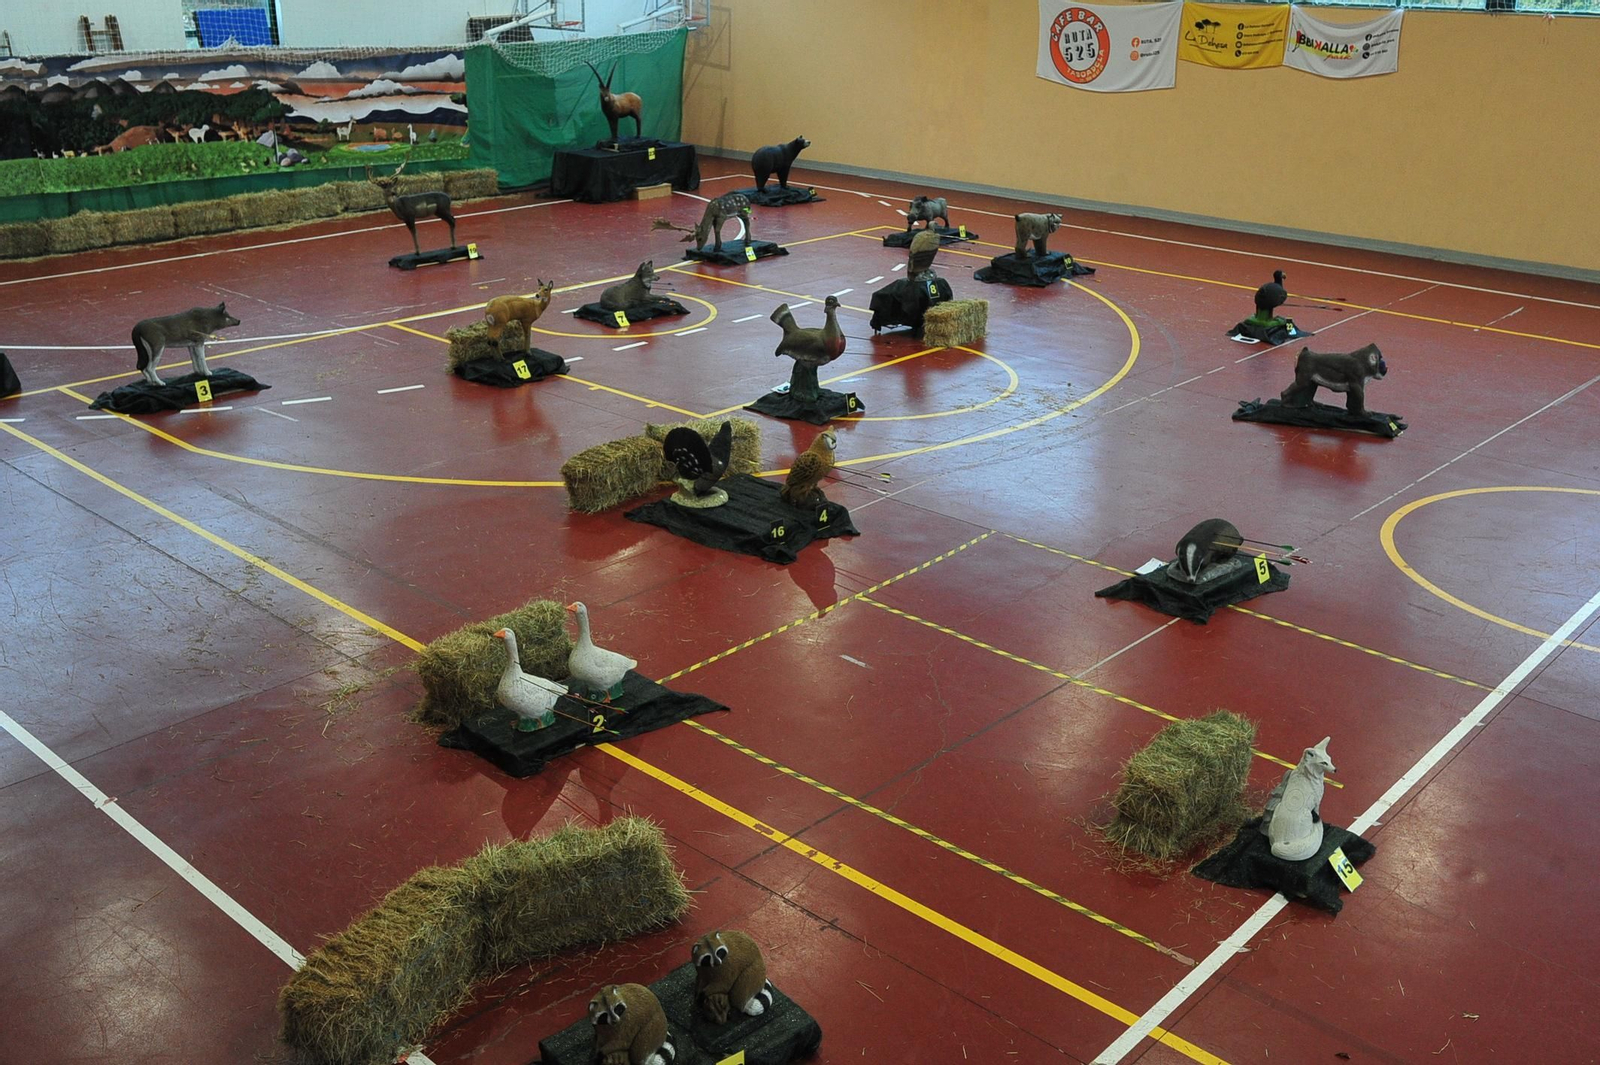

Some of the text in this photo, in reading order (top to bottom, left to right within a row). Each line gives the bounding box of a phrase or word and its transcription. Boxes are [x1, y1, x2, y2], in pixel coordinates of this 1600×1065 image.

[1078, 10, 1103, 33] BAR
[1064, 42, 1096, 63] 525
[930, 284, 937, 294] 8
[617, 315, 624, 323] 7
[517, 364, 527, 375] 17
[200, 385, 208, 396] 3
[849, 397, 856, 408] 6
[819, 509, 828, 522] 4
[771, 525, 785, 538] 16
[1258, 560, 1266, 575] 5
[592, 714, 605, 733] 2
[1337, 857, 1354, 879] 15
